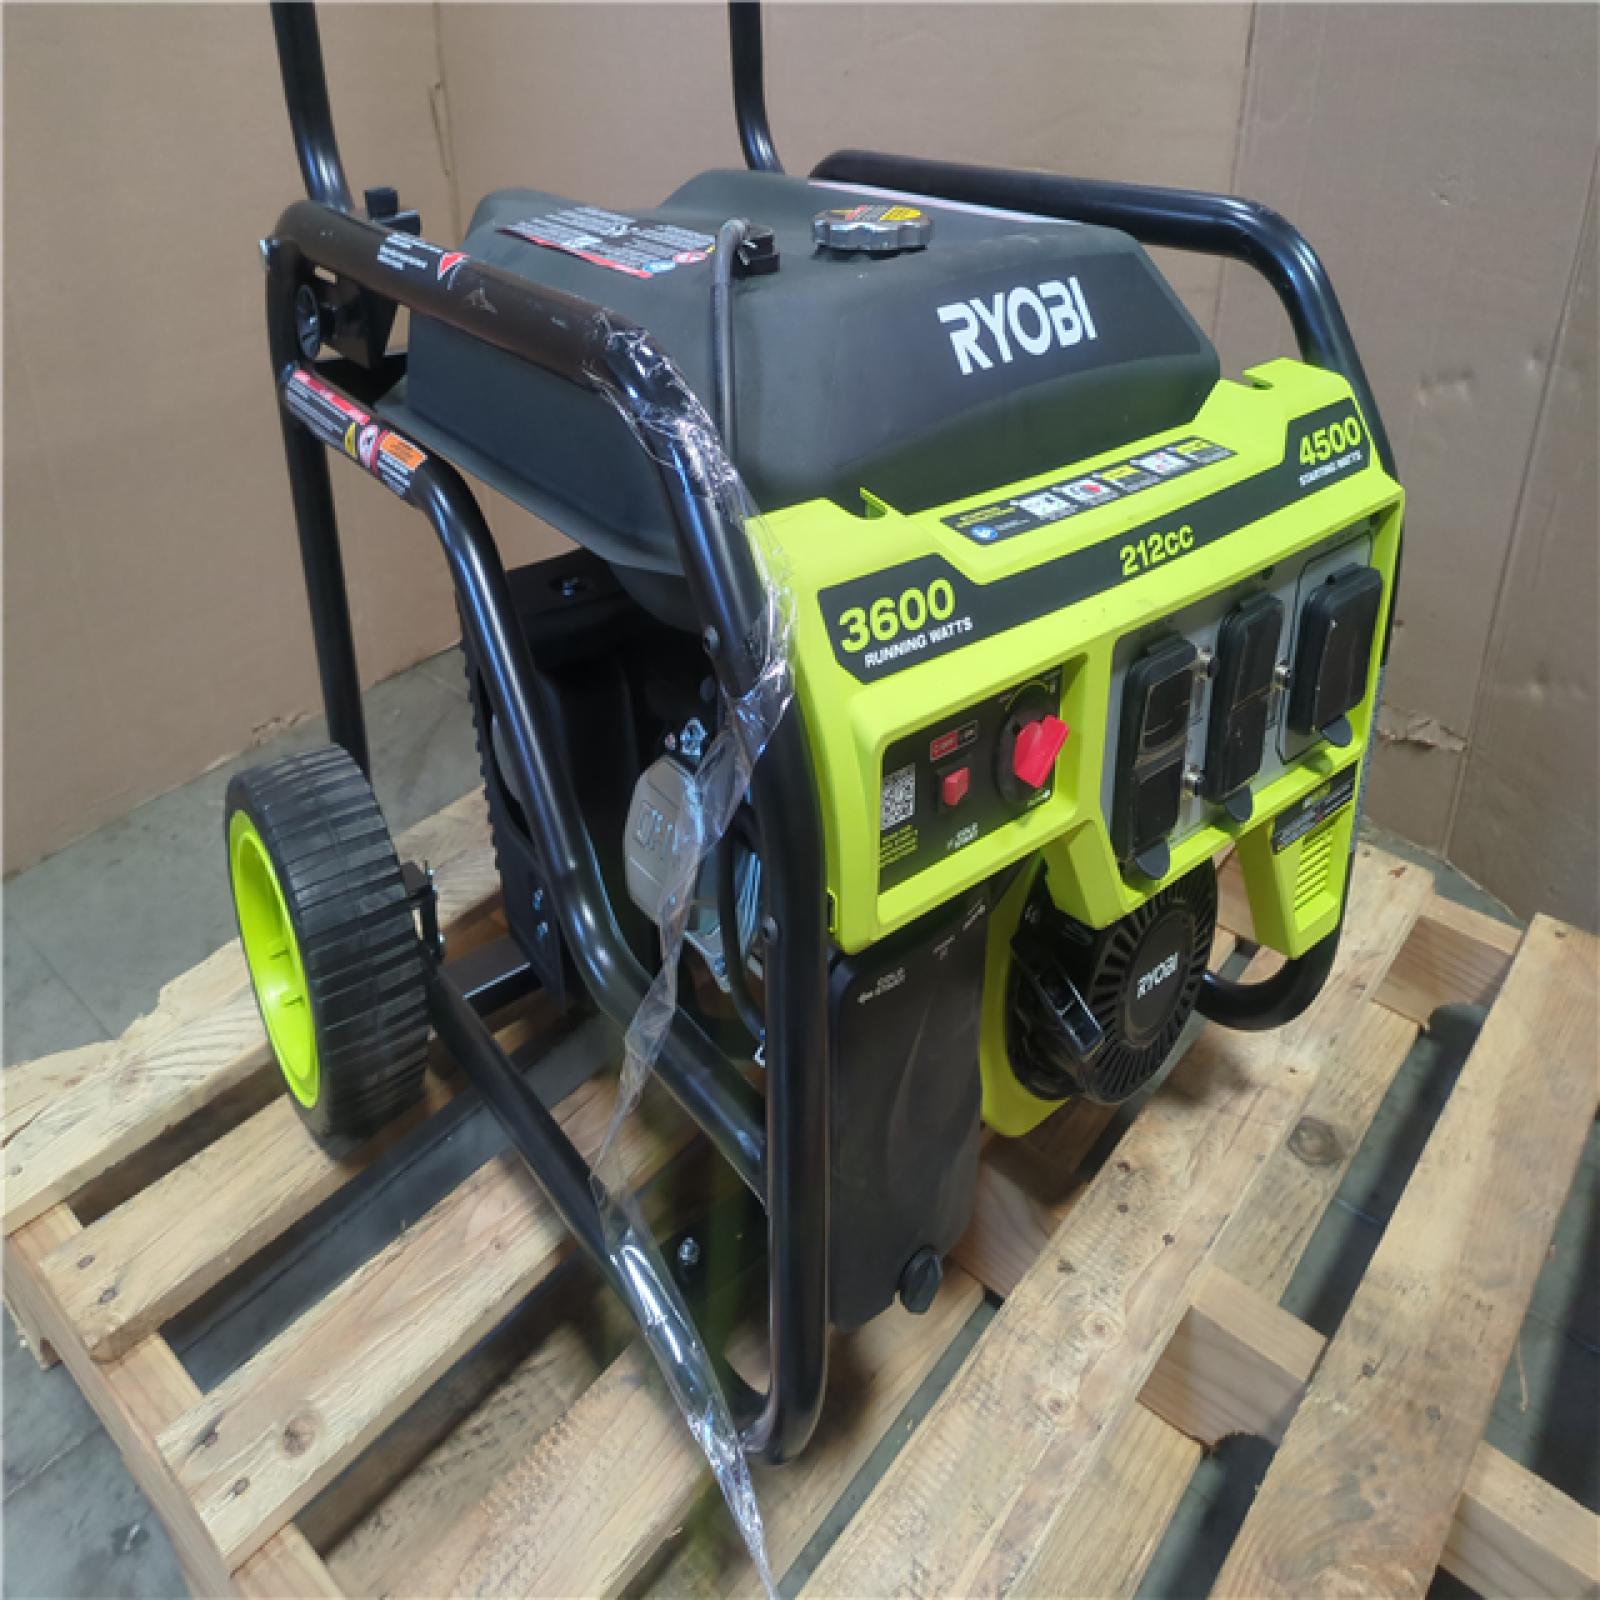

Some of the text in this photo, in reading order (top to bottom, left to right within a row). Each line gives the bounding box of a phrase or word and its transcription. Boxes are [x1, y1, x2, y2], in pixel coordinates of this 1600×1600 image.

[937, 276, 1097, 375] RYOBI
[1300, 416, 1361, 465] 4500
[1120, 524, 1194, 575] 212cc
[840, 578, 955, 652] 3600
[865, 617, 973, 668] RUNNING WATTS
[1137, 952, 1178, 999] RYOBI
